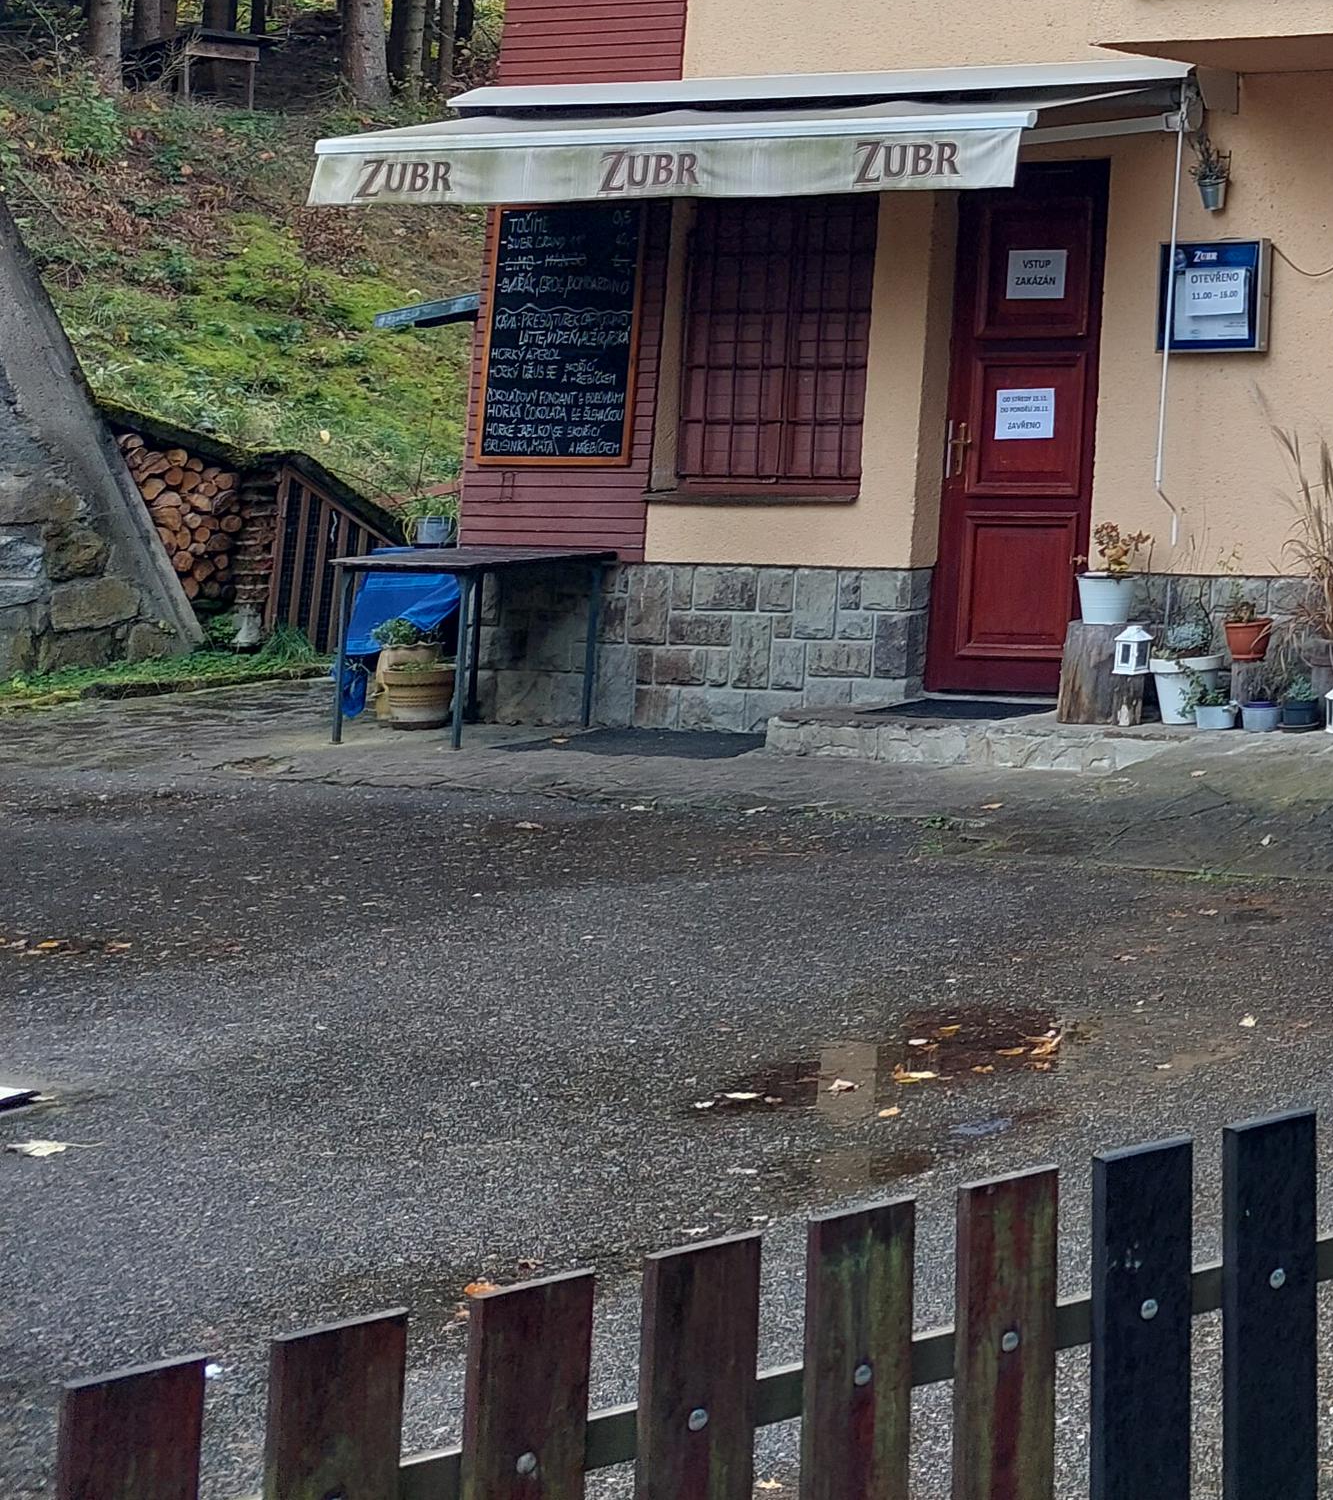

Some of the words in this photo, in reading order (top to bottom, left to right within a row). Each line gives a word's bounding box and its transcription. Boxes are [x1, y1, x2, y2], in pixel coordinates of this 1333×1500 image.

[357, 159, 453, 198] ZUBR
[601, 150, 700, 192] ZUBR
[854, 141, 962, 186] ZUBR
[1016, 274, 1056, 285] ZAKÁZÁN
[1023, 260, 1051, 268] VSTUP
